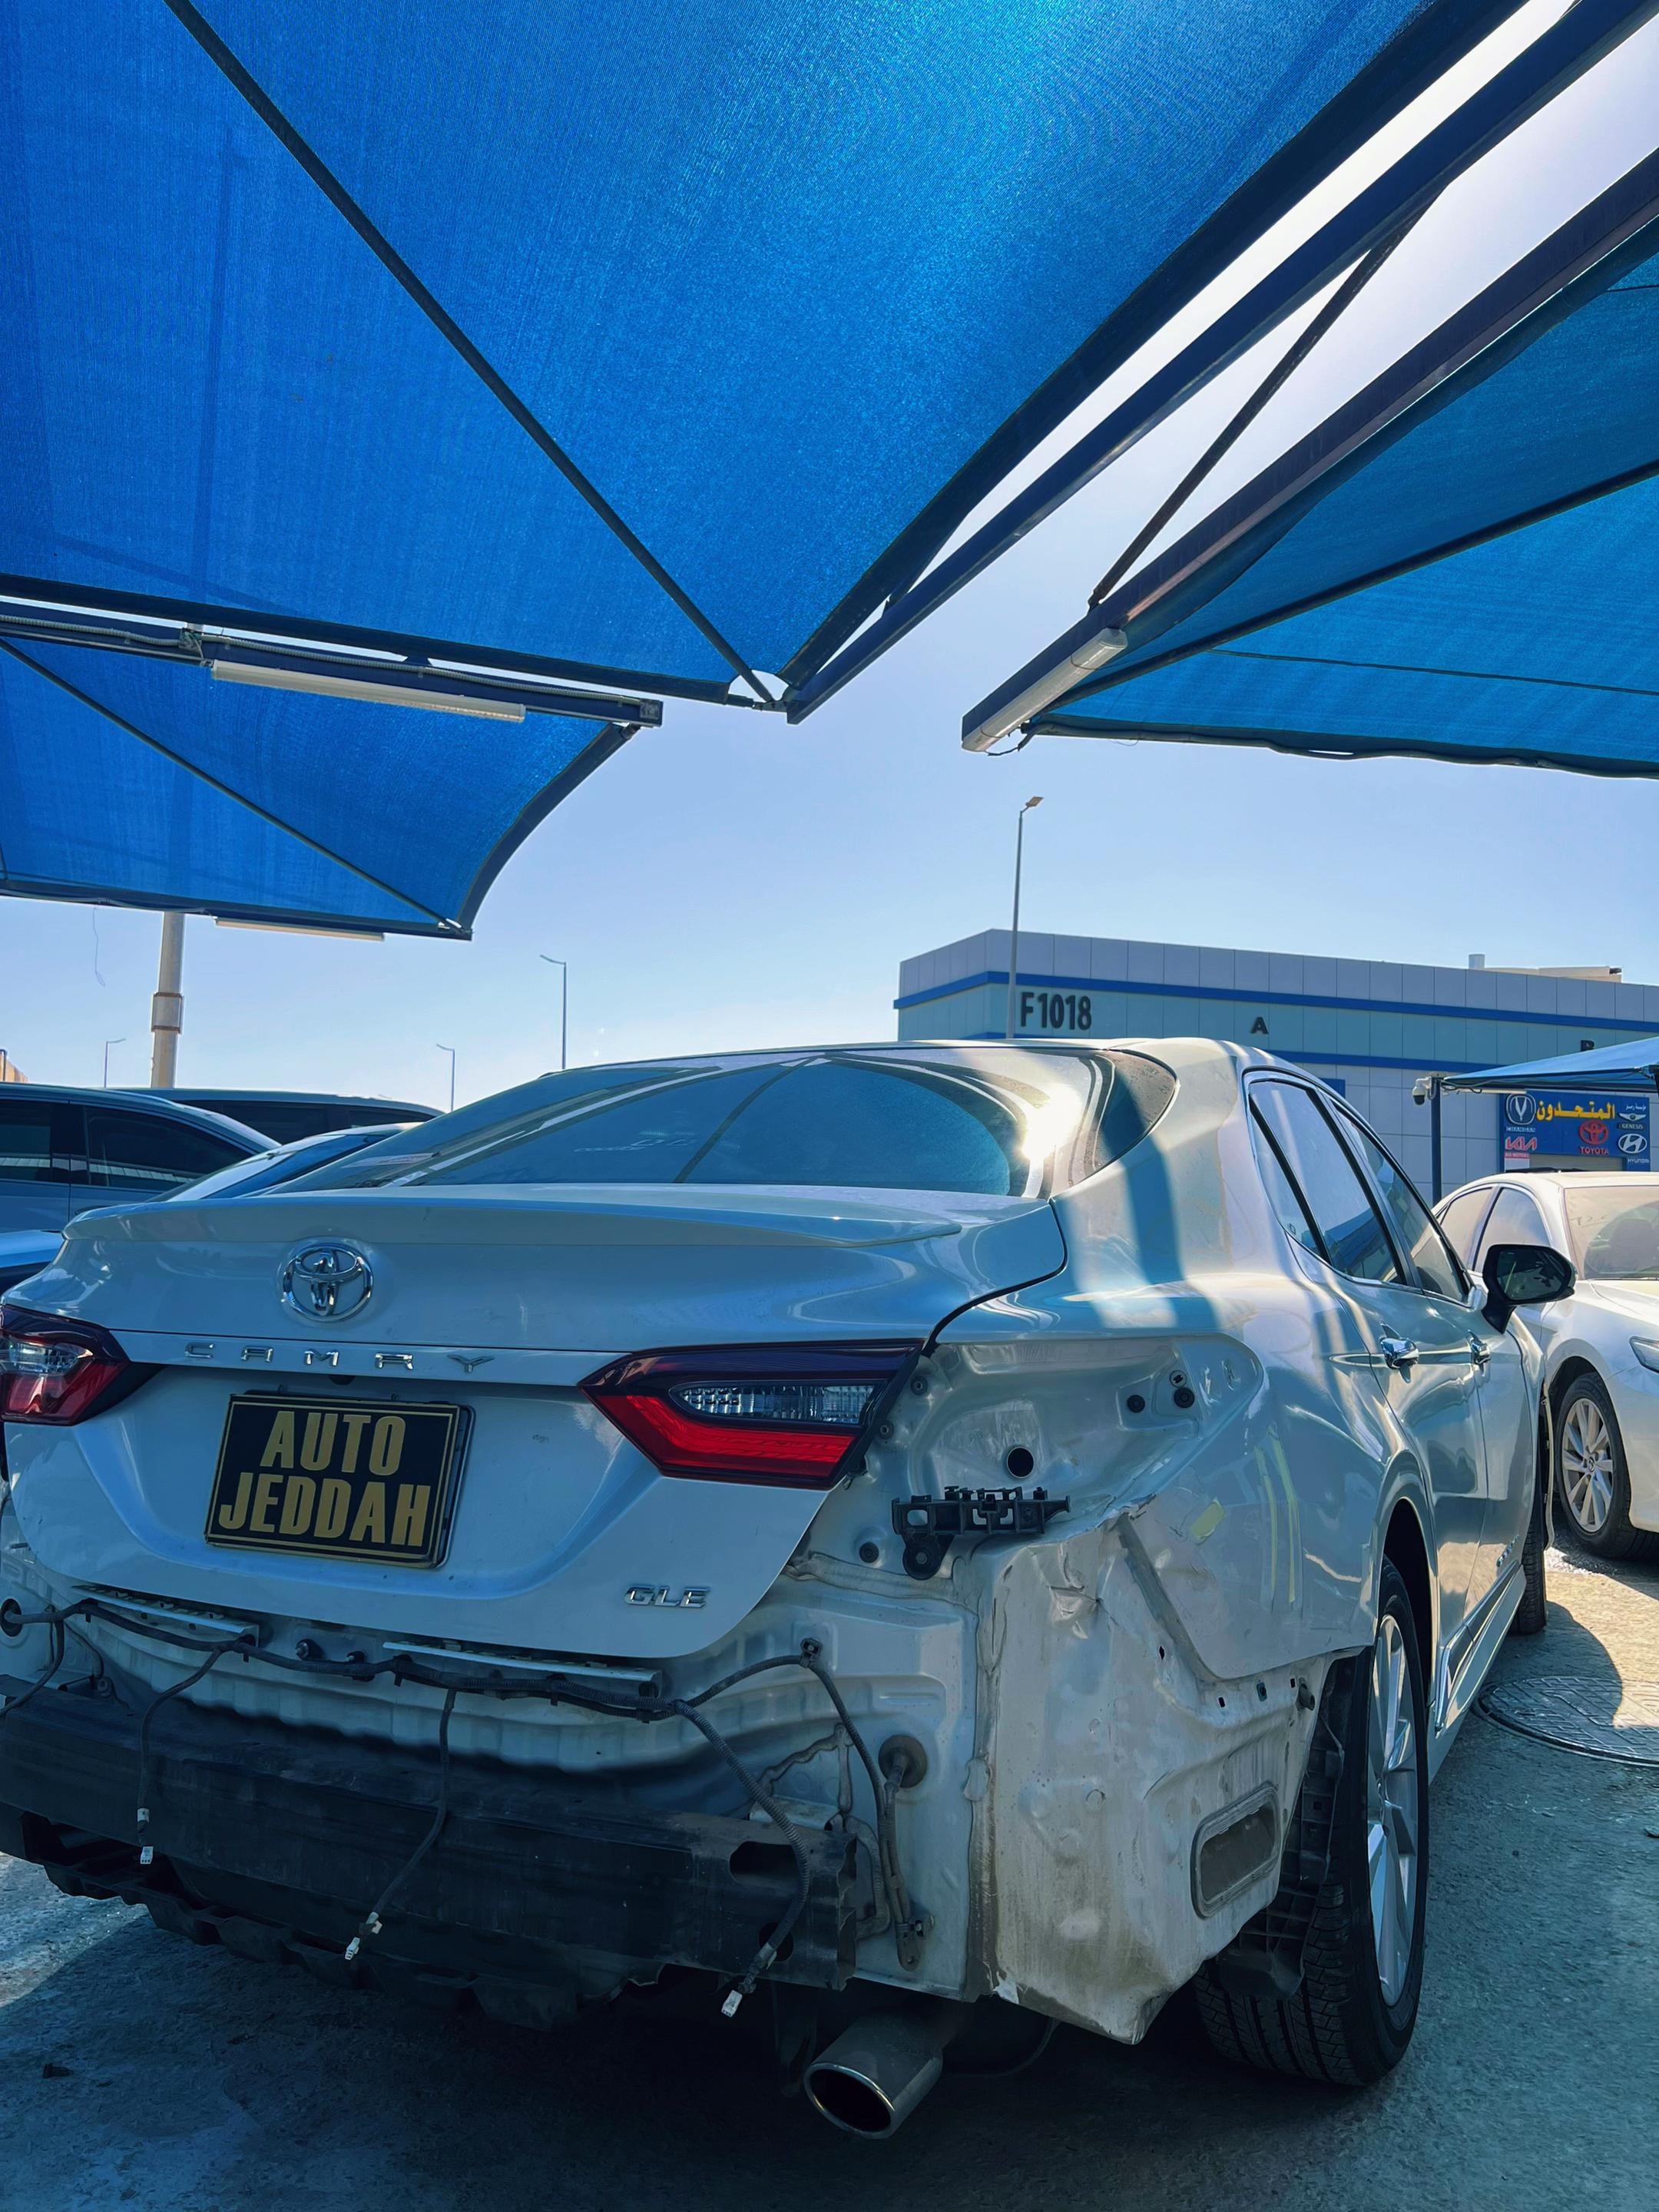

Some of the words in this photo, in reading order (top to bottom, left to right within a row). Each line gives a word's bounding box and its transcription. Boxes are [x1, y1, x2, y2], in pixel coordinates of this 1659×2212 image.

[1250, 1016, 1269, 1035] A
[1536, 1100, 1615, 1121] المتحدون
[1580, 1146, 1608, 1155] TOYOTA
[184, 1342, 495, 1373] CAMRY
[260, 1411, 406, 1476] AUTO
[218, 1472, 431, 1547] JEDDAH
[624, 1584, 710, 1608] GLE
